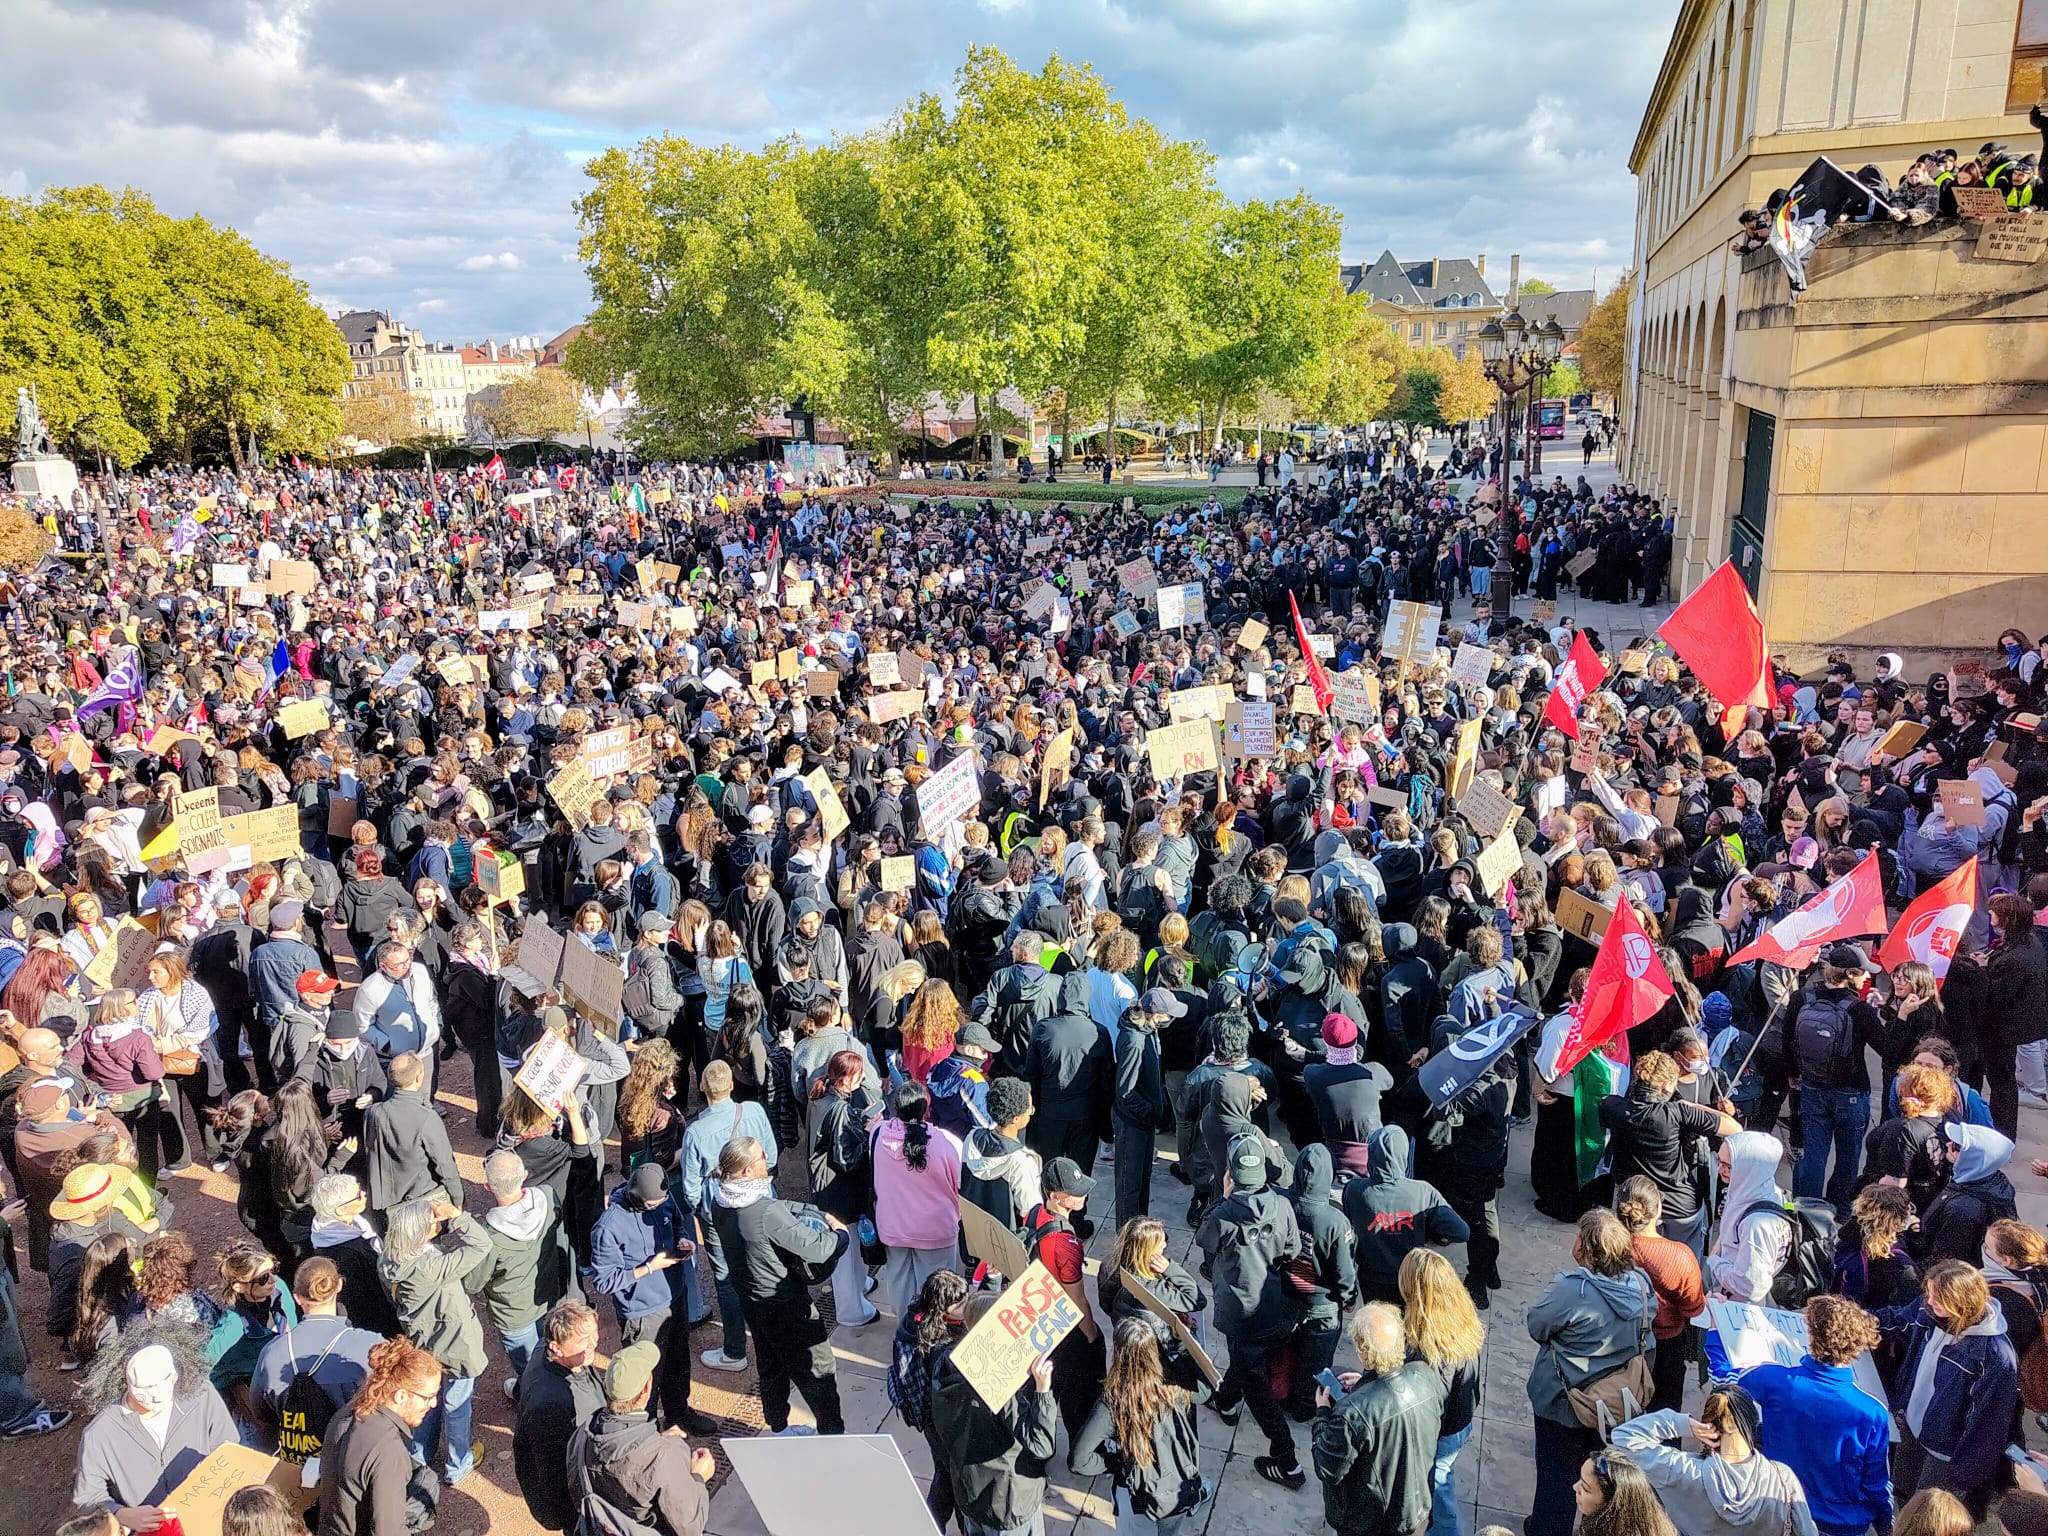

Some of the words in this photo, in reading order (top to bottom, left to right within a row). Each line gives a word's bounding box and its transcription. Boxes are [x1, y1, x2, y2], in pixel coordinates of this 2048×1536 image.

[1184, 751, 1205, 771] RN
[100, 952, 114, 966] DE
[117, 949, 131, 965] LES
[1367, 1211, 1414, 1234] AIR
[961, 1329, 1000, 1377] JE
[998, 1267, 1063, 1338] PENSE
[978, 1353, 1019, 1402] DONC
[1008, 1333, 1034, 1364] JE
[1029, 1297, 1076, 1353] GÊNE
[180, 1455, 229, 1506] MARRE
[210, 1469, 245, 1499] DES
